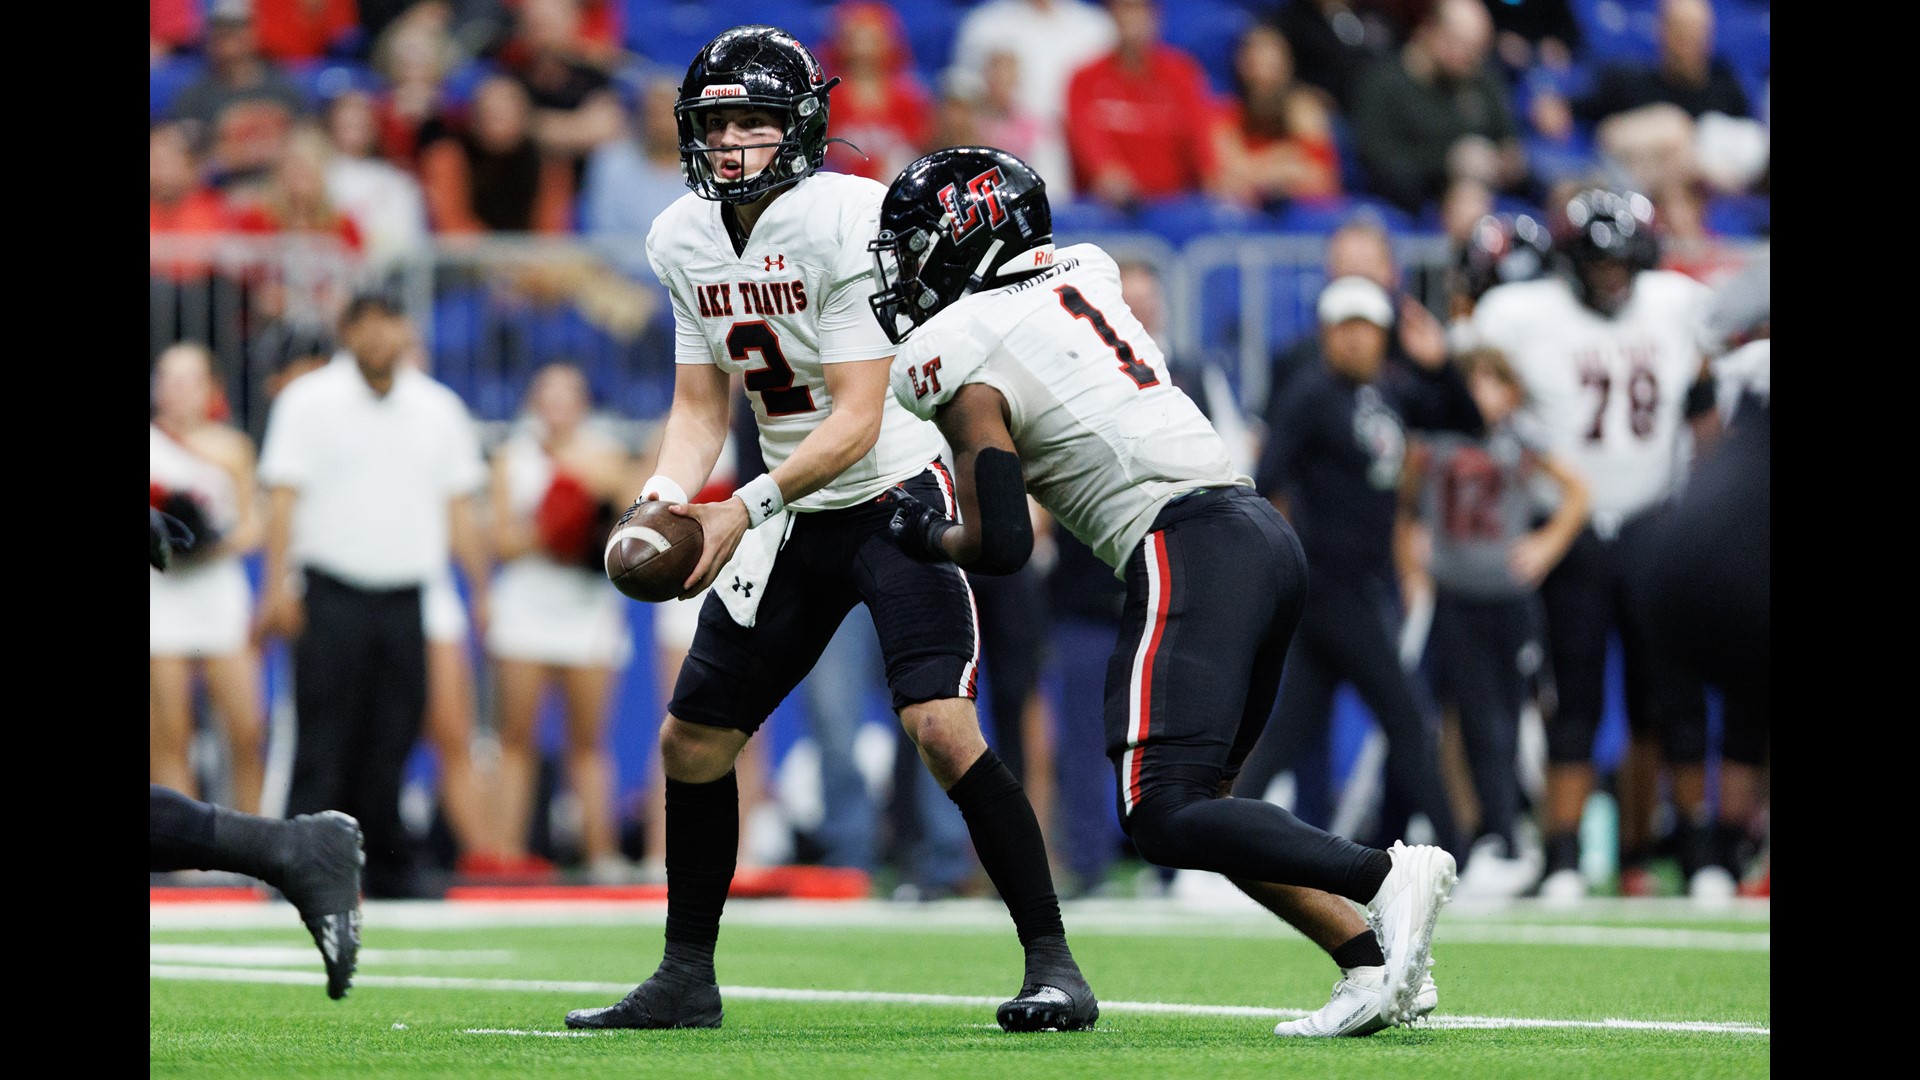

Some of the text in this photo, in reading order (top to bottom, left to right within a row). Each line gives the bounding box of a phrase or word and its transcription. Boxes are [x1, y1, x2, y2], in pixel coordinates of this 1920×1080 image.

[704, 87, 742, 97] Riddell
[937, 165, 1010, 246] LT
[691, 279, 808, 318] AKE TRAVIS
[1052, 282, 1161, 391] 1
[725, 319, 818, 417] 2
[907, 355, 943, 401] LT
[1578, 366, 1660, 442] 78
